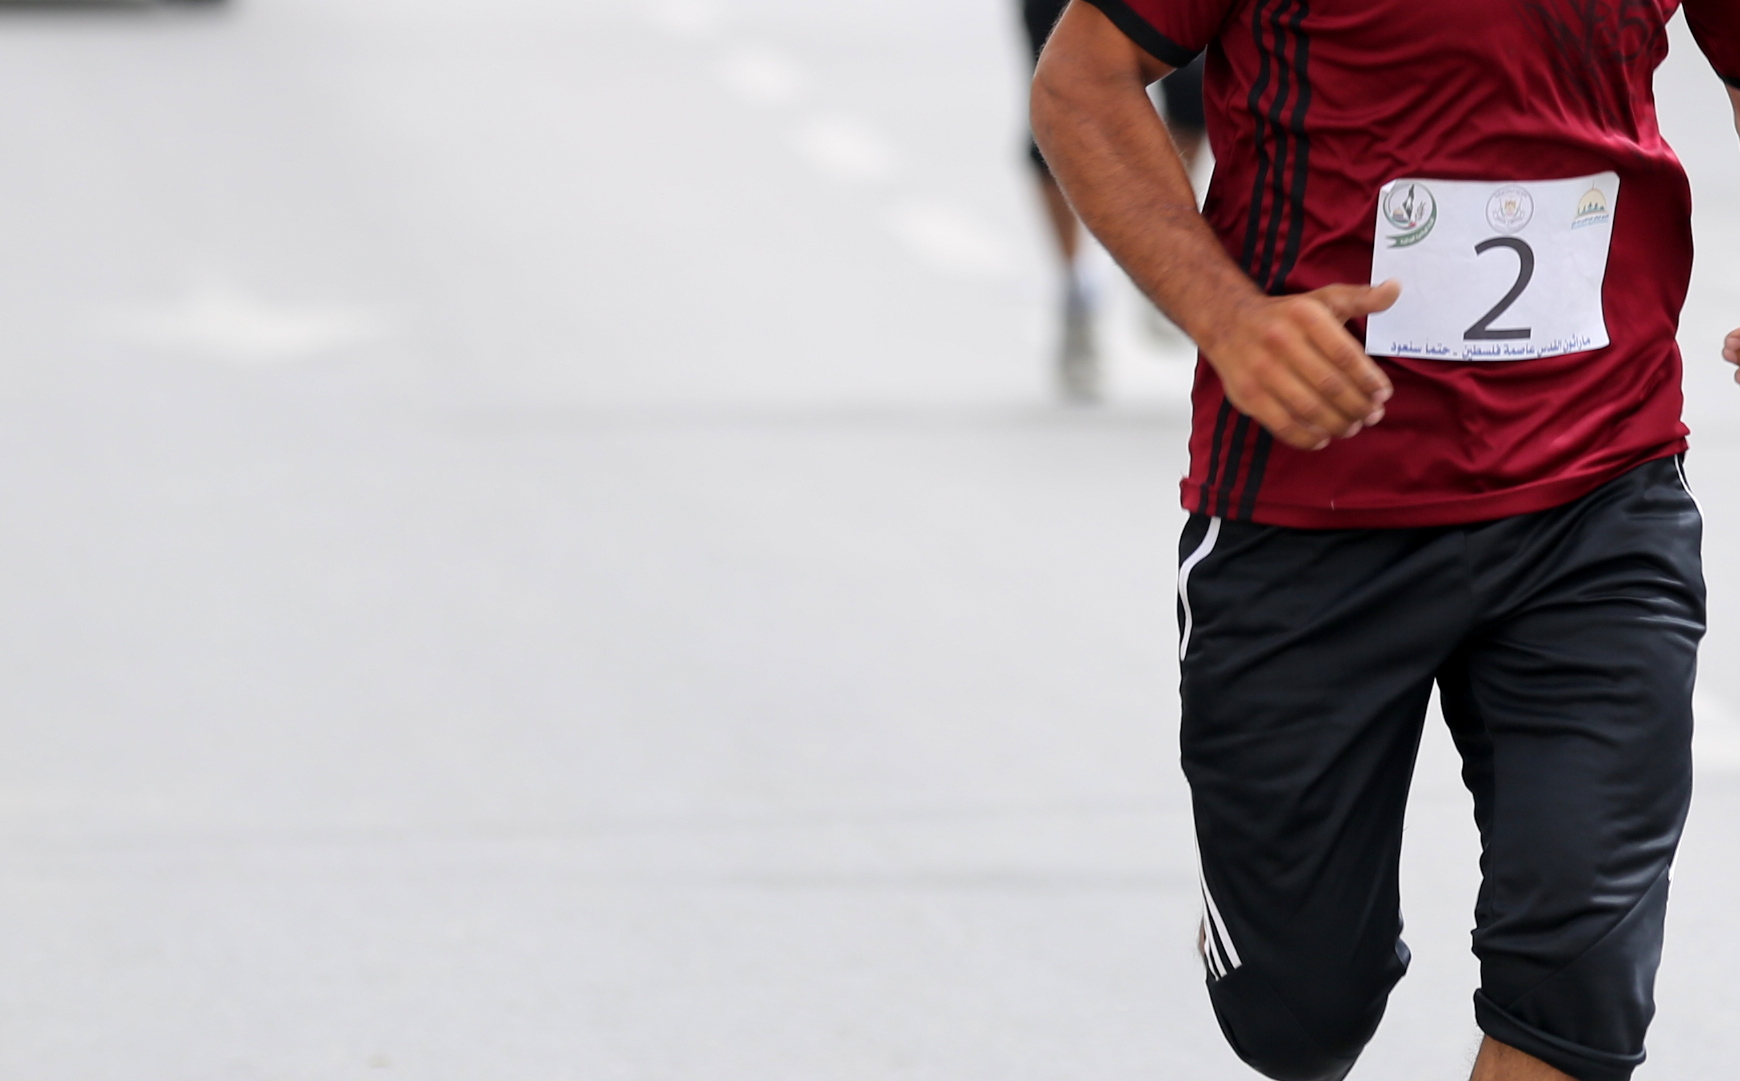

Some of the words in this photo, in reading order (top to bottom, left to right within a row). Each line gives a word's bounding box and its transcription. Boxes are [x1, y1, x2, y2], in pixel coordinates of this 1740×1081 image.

[1462, 236, 1535, 341] 2
[1390, 340, 1422, 356] سنعود
[1462, 343, 1501, 361] فلسطين
[1503, 343, 1535, 355] عاصمة
[1537, 339, 1562, 358] القدس
[1562, 333, 1591, 353] ماراثون
